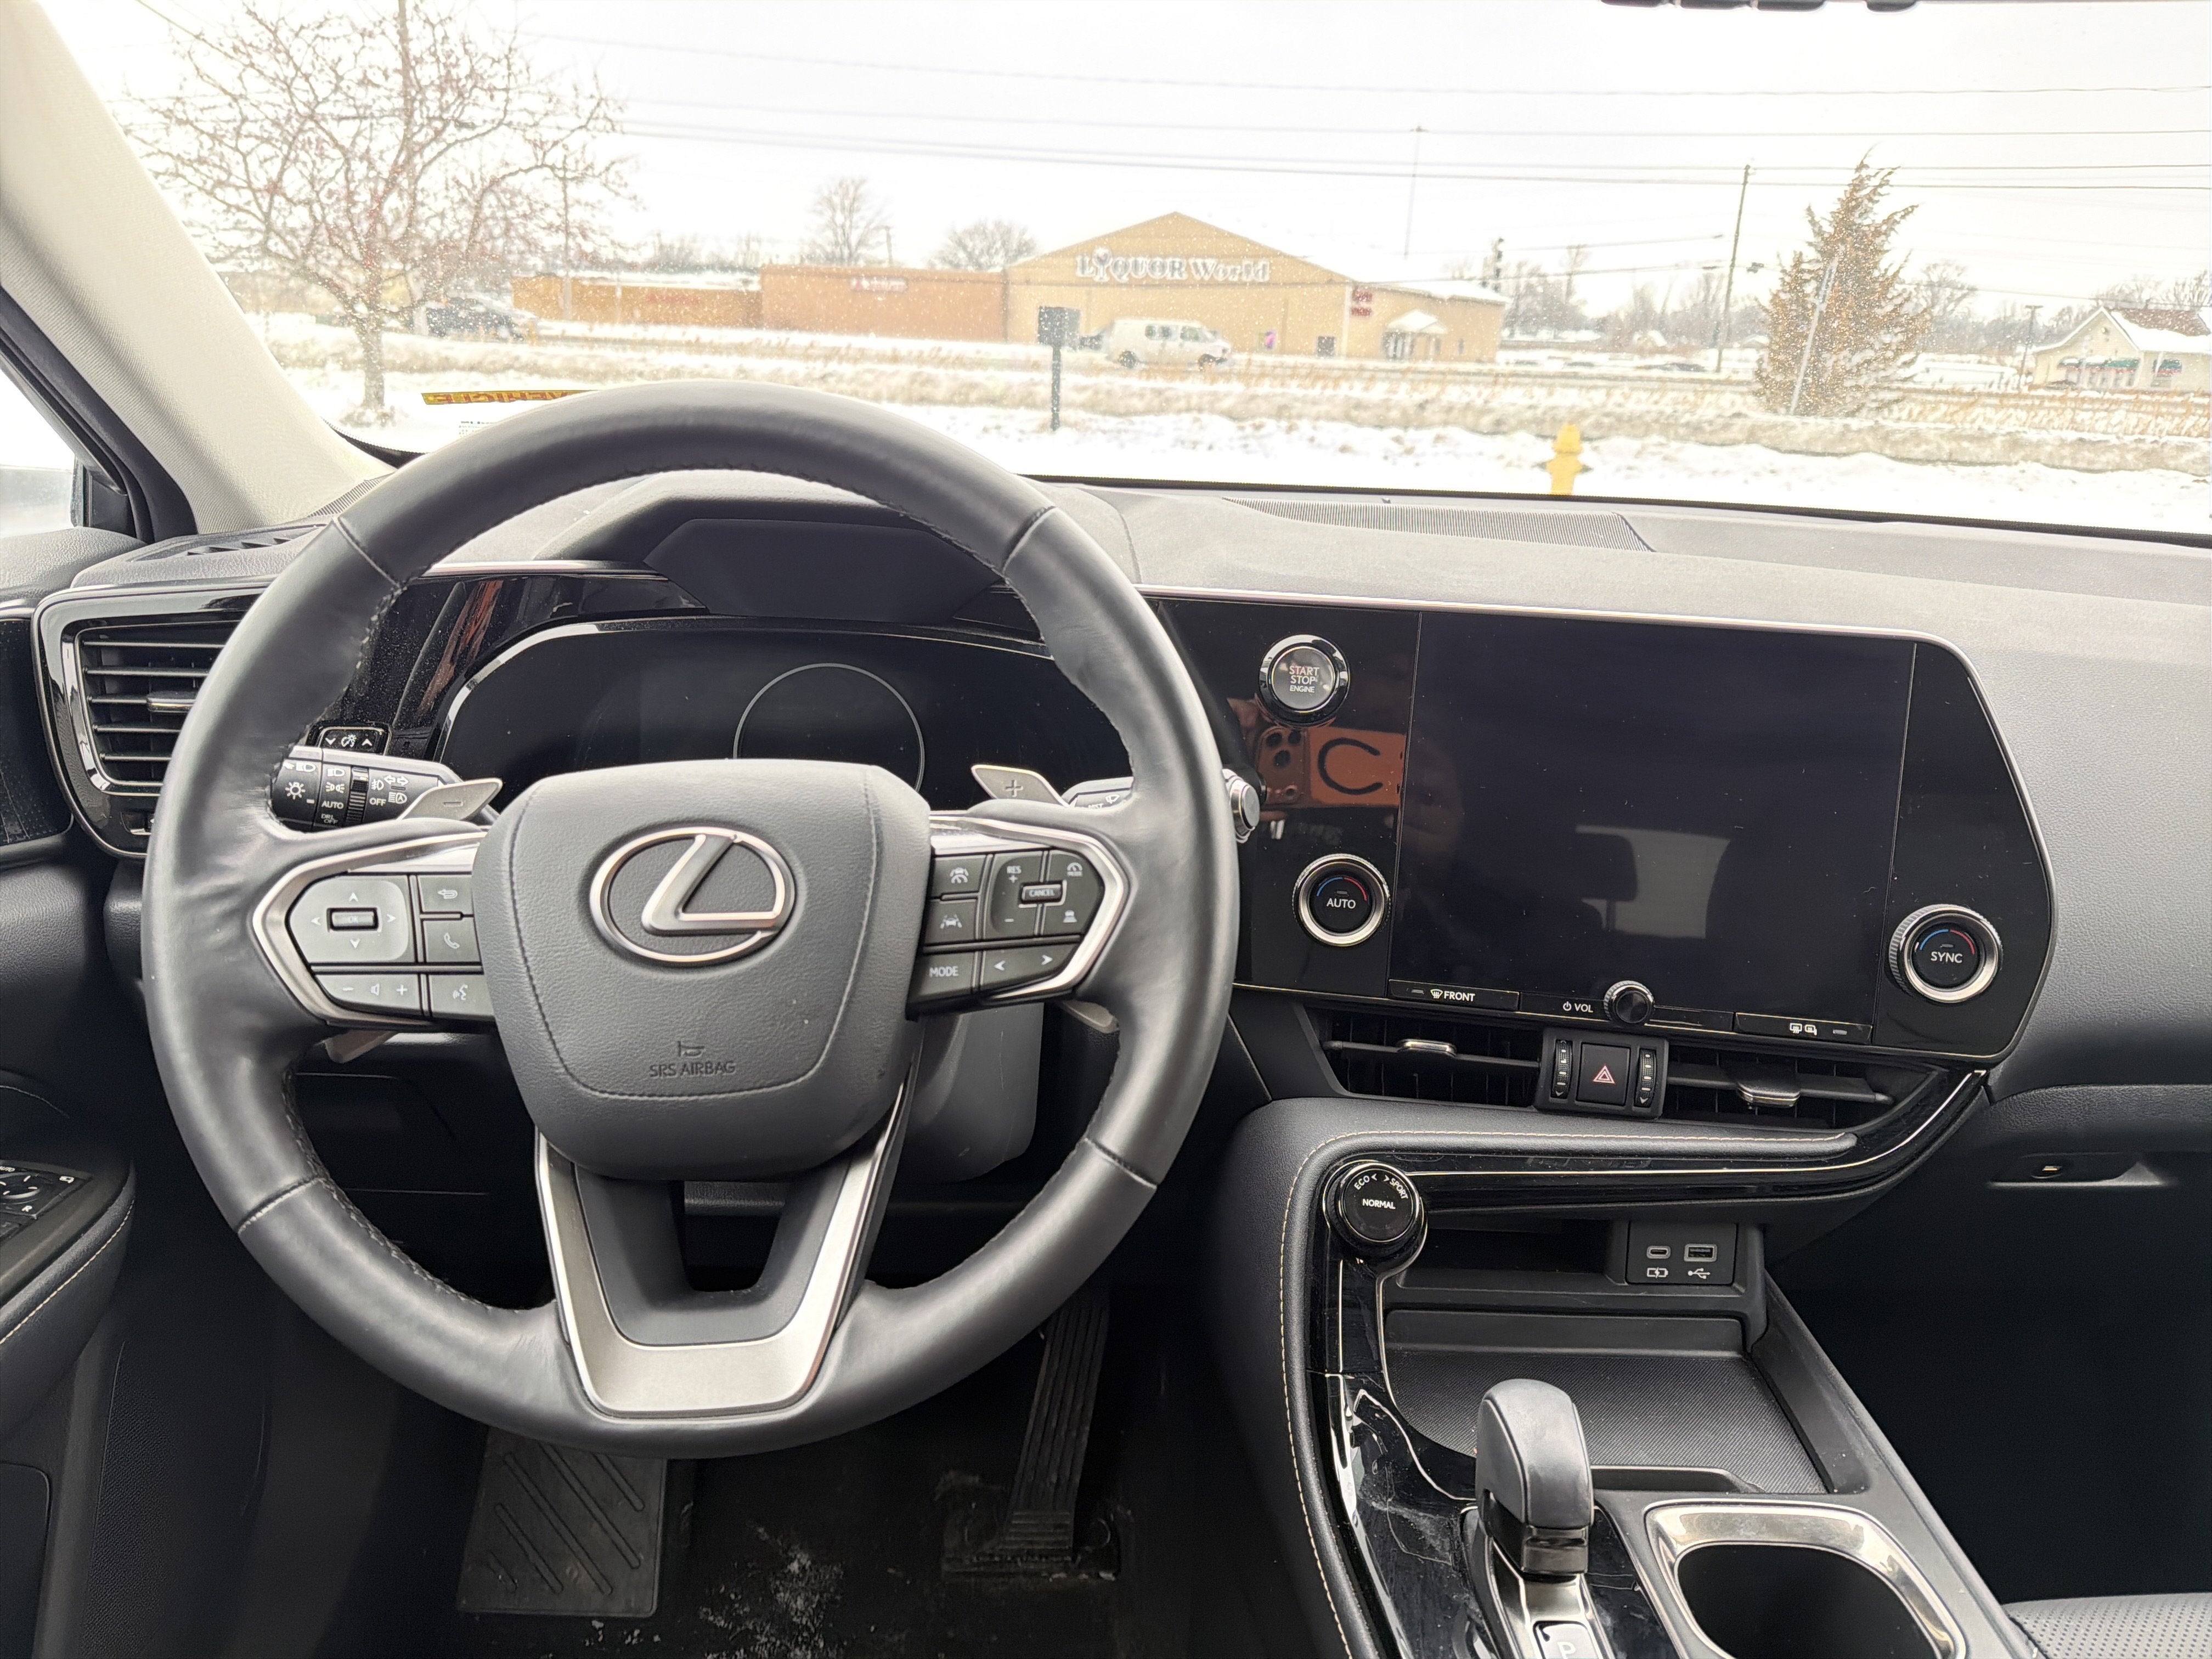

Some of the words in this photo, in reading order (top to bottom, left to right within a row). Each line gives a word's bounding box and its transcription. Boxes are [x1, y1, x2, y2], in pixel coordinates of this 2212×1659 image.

[1189, 258, 1270, 281] World
[1289, 665, 1320, 676] START
[1290, 675, 1316, 685] STOP
[321, 800, 344, 809] AUTO
[370, 797, 386, 806] OFF
[1327, 898, 1356, 909] AUTO
[1931, 951, 1963, 963] SYNC
[929, 966, 958, 977] MODE
[1444, 990, 1475, 1002] FRONT
[1575, 1003, 1593, 1013] VOL
[650, 1063, 677, 1077] SRS
[680, 1060, 736, 1076] AIRBAG
[1354, 1175, 1370, 1190] ECO
[1390, 1178, 1408, 1199] SPORT
[1362, 1199, 1396, 1210] NORMAL
